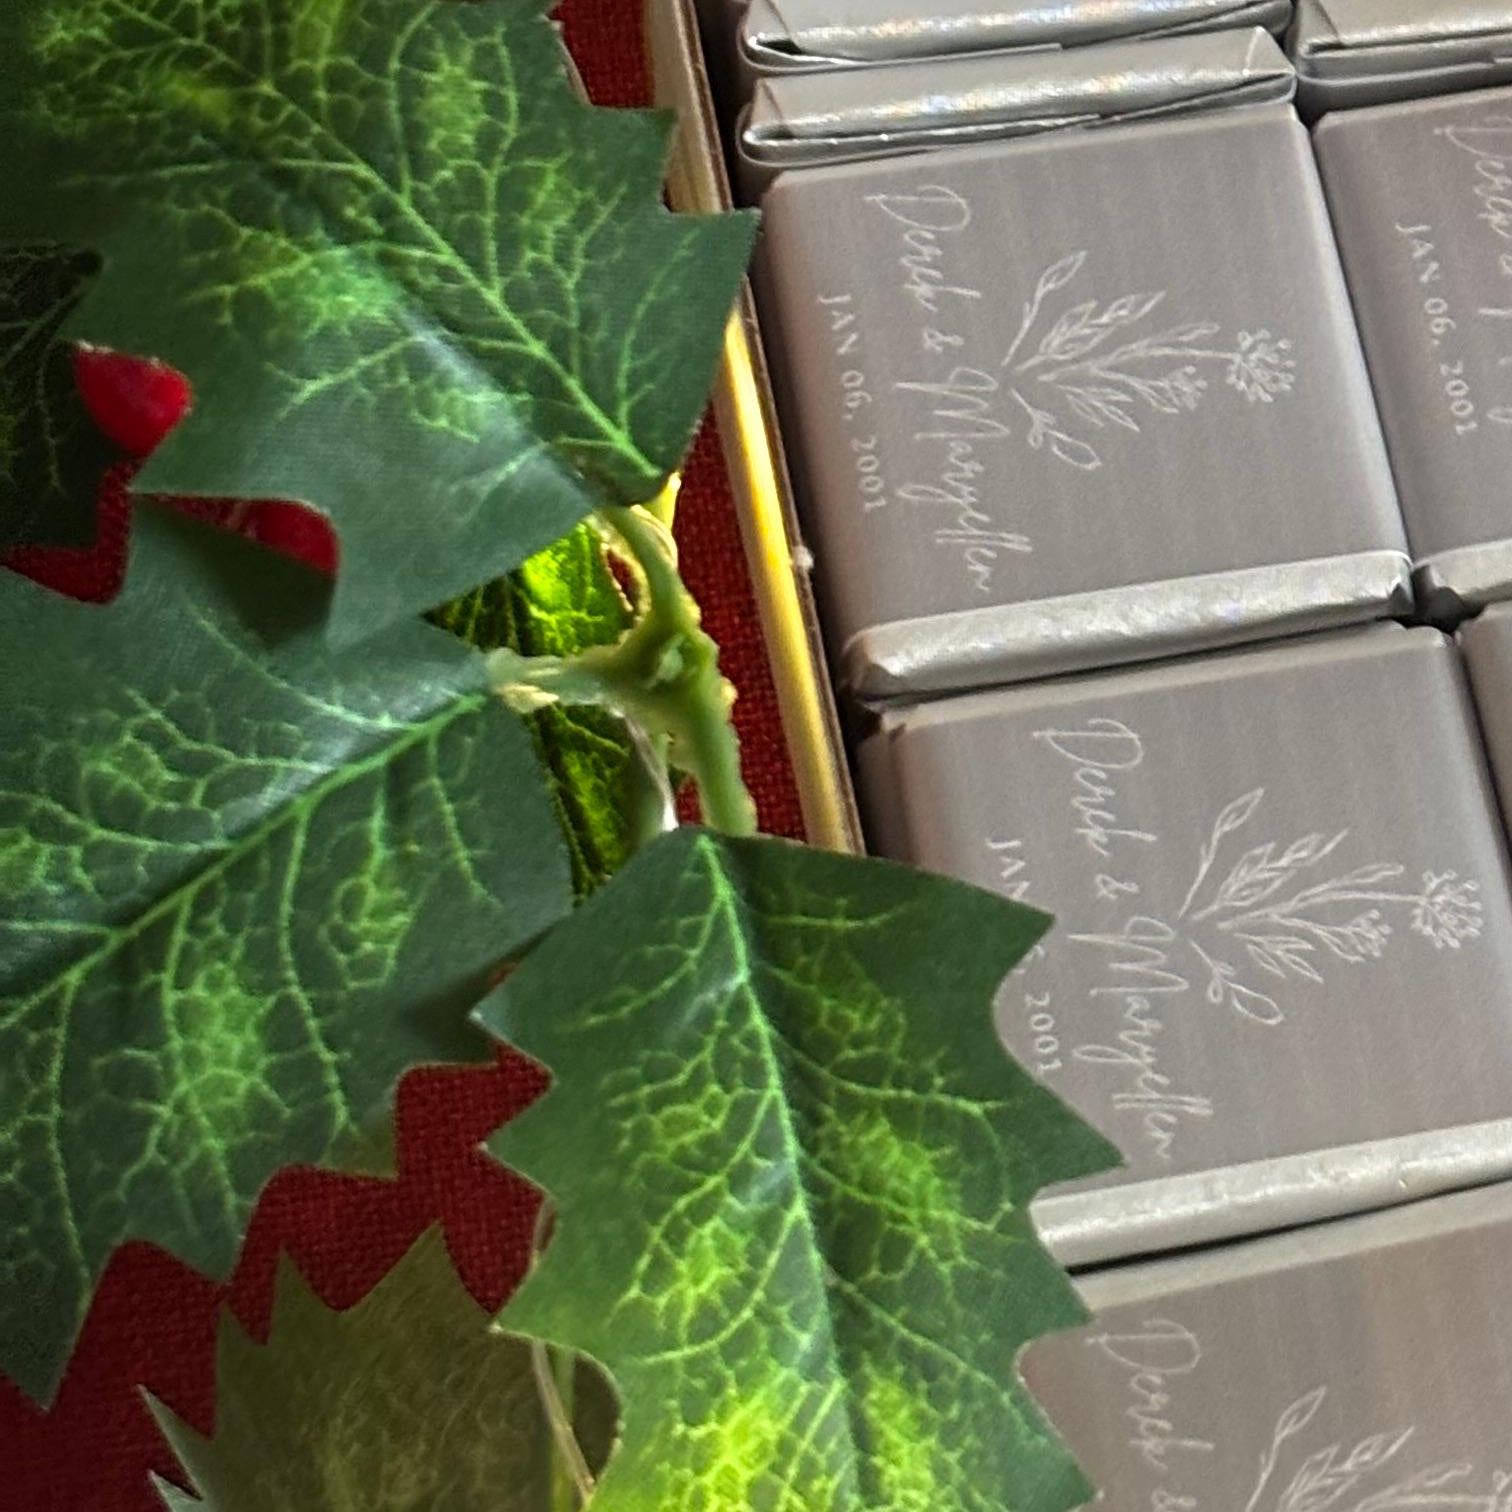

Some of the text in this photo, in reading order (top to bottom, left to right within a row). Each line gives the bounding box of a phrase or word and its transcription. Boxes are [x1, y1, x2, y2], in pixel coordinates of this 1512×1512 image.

[817, 293, 862, 355] JAN
[851, 437, 888, 514] 2001
[1395, 222, 1441, 283] JAN
[1440, 360, 1478, 435] 2001
[1025, 992, 1061, 1072] 2001
